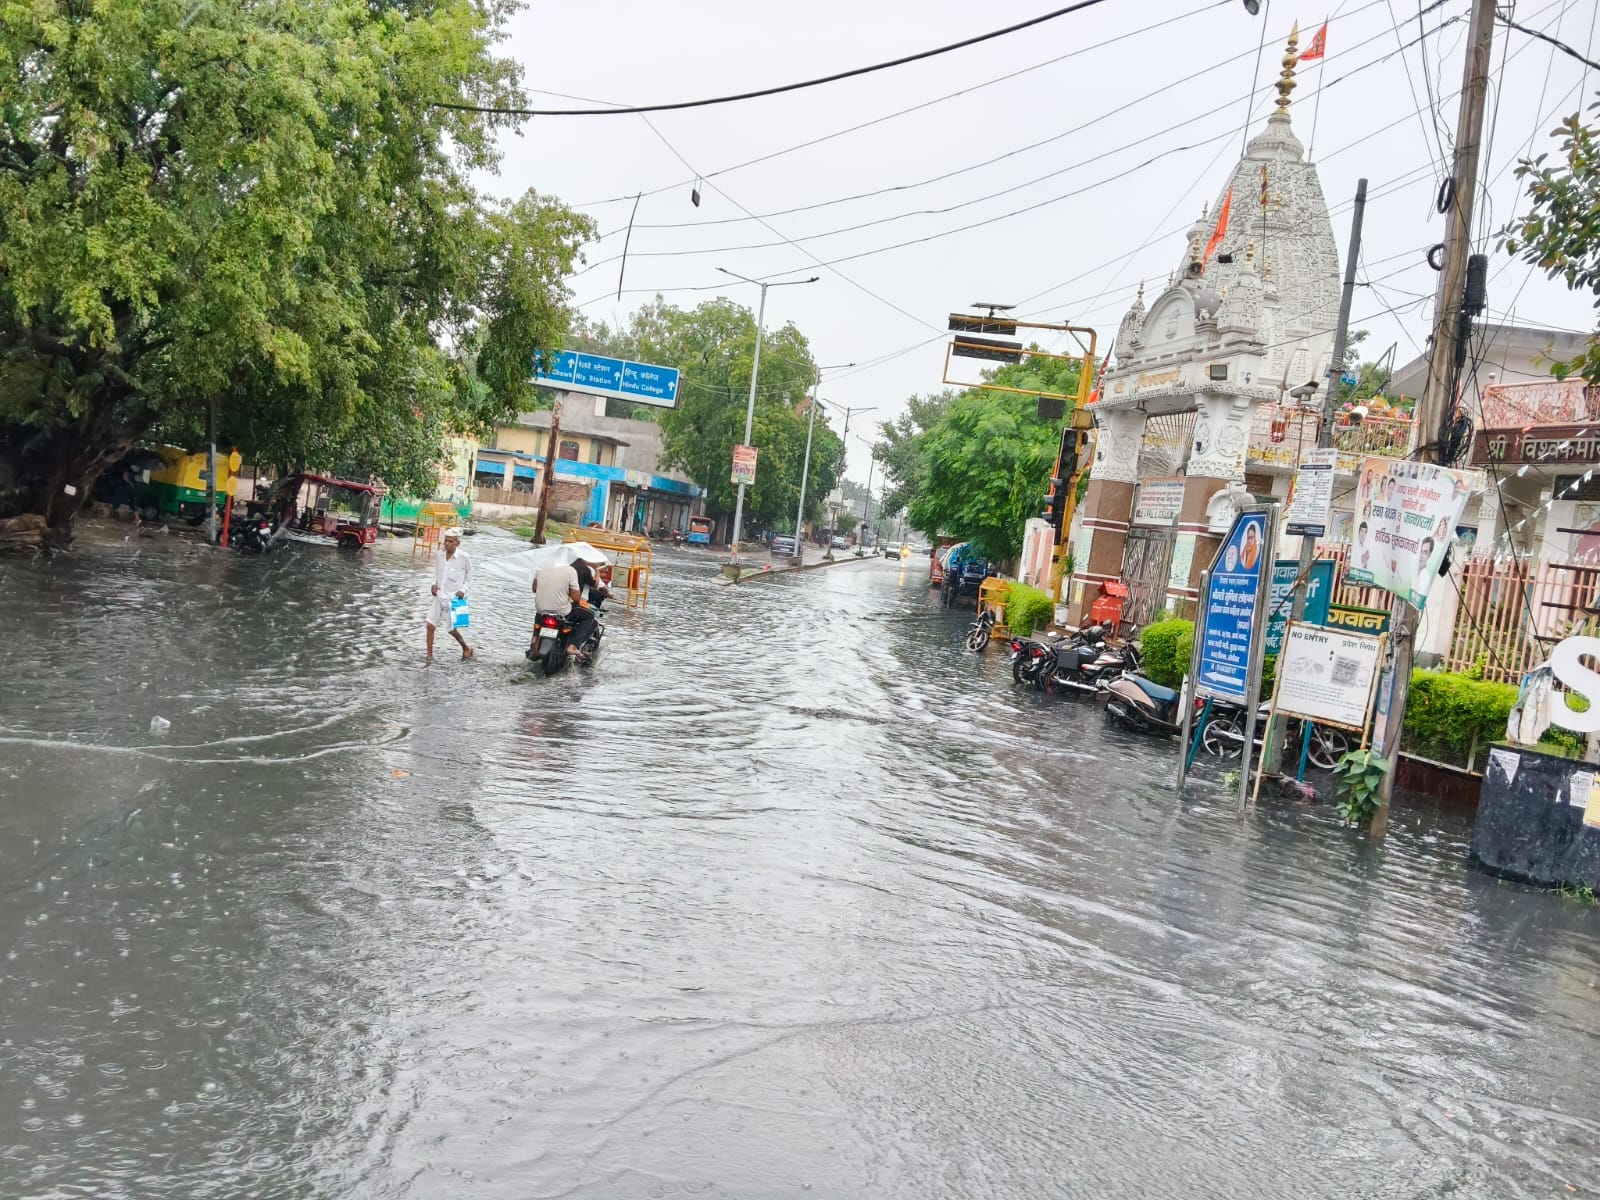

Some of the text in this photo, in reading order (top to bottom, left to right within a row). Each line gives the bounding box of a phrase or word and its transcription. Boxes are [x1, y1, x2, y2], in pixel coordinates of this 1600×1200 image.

[588, 375, 612, 385] Station
[622, 381, 664, 395] Hindu College
[1488, 434, 1511, 460] श्री
[1372, 505, 1384, 518] रक्षा
[1328, 609, 1385, 630] गवान
[1291, 631, 1329, 645] NO ENTRY
